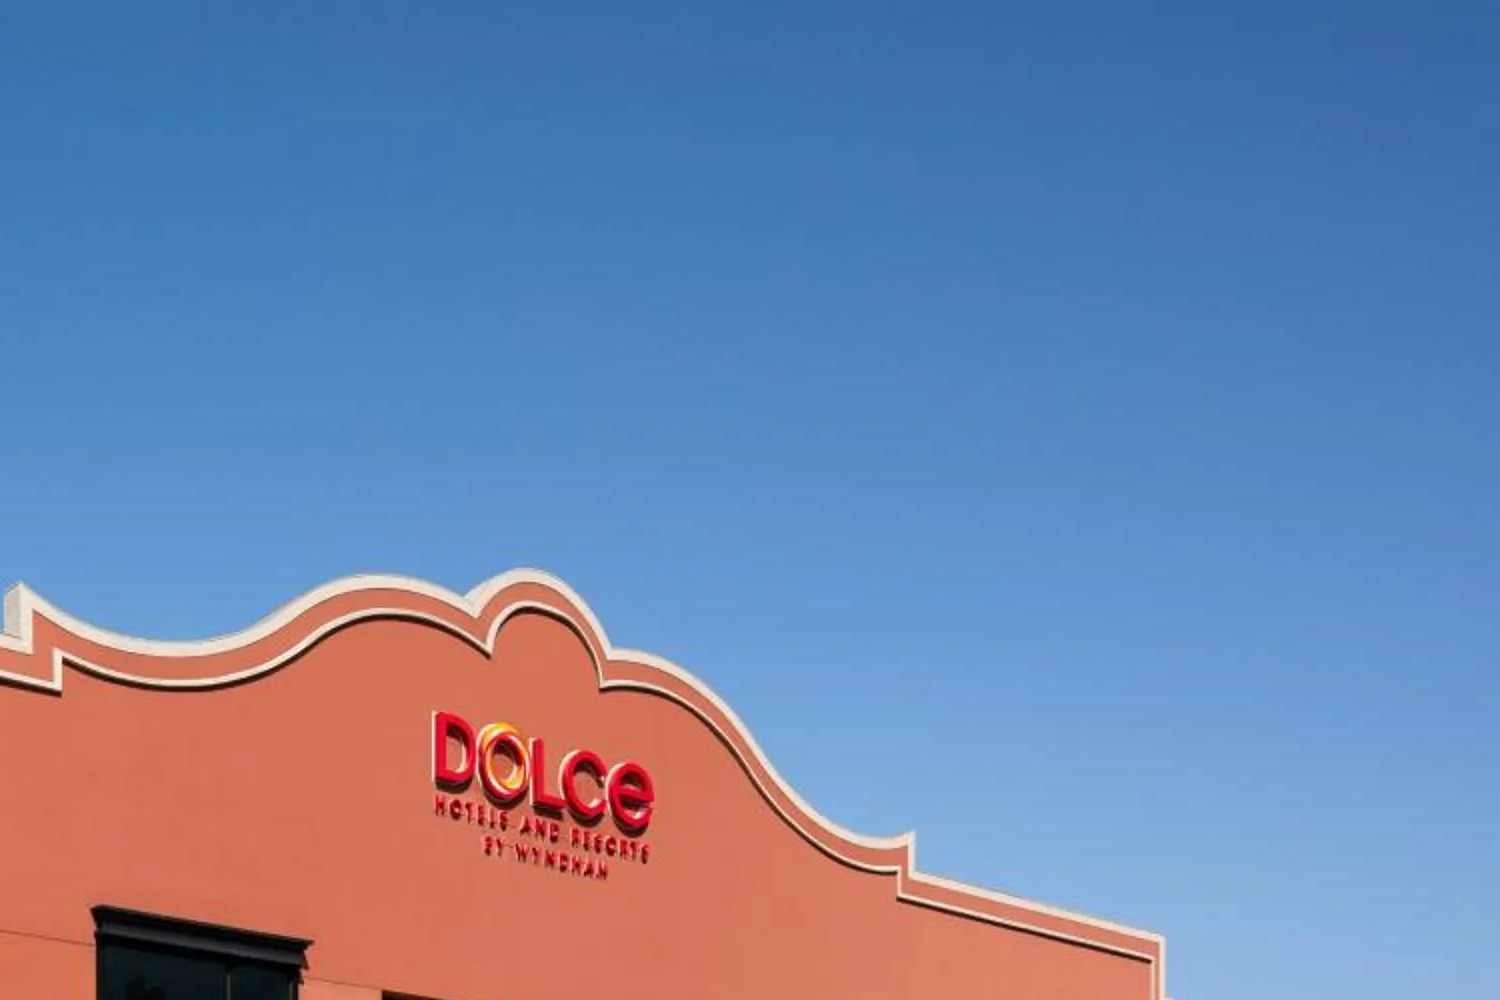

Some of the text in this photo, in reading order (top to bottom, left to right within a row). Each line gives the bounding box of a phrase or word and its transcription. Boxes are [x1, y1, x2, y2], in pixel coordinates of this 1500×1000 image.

[435, 795, 649, 864] HOTELS AND RESORTS
[484, 836, 608, 880] BY WYNDHAM
